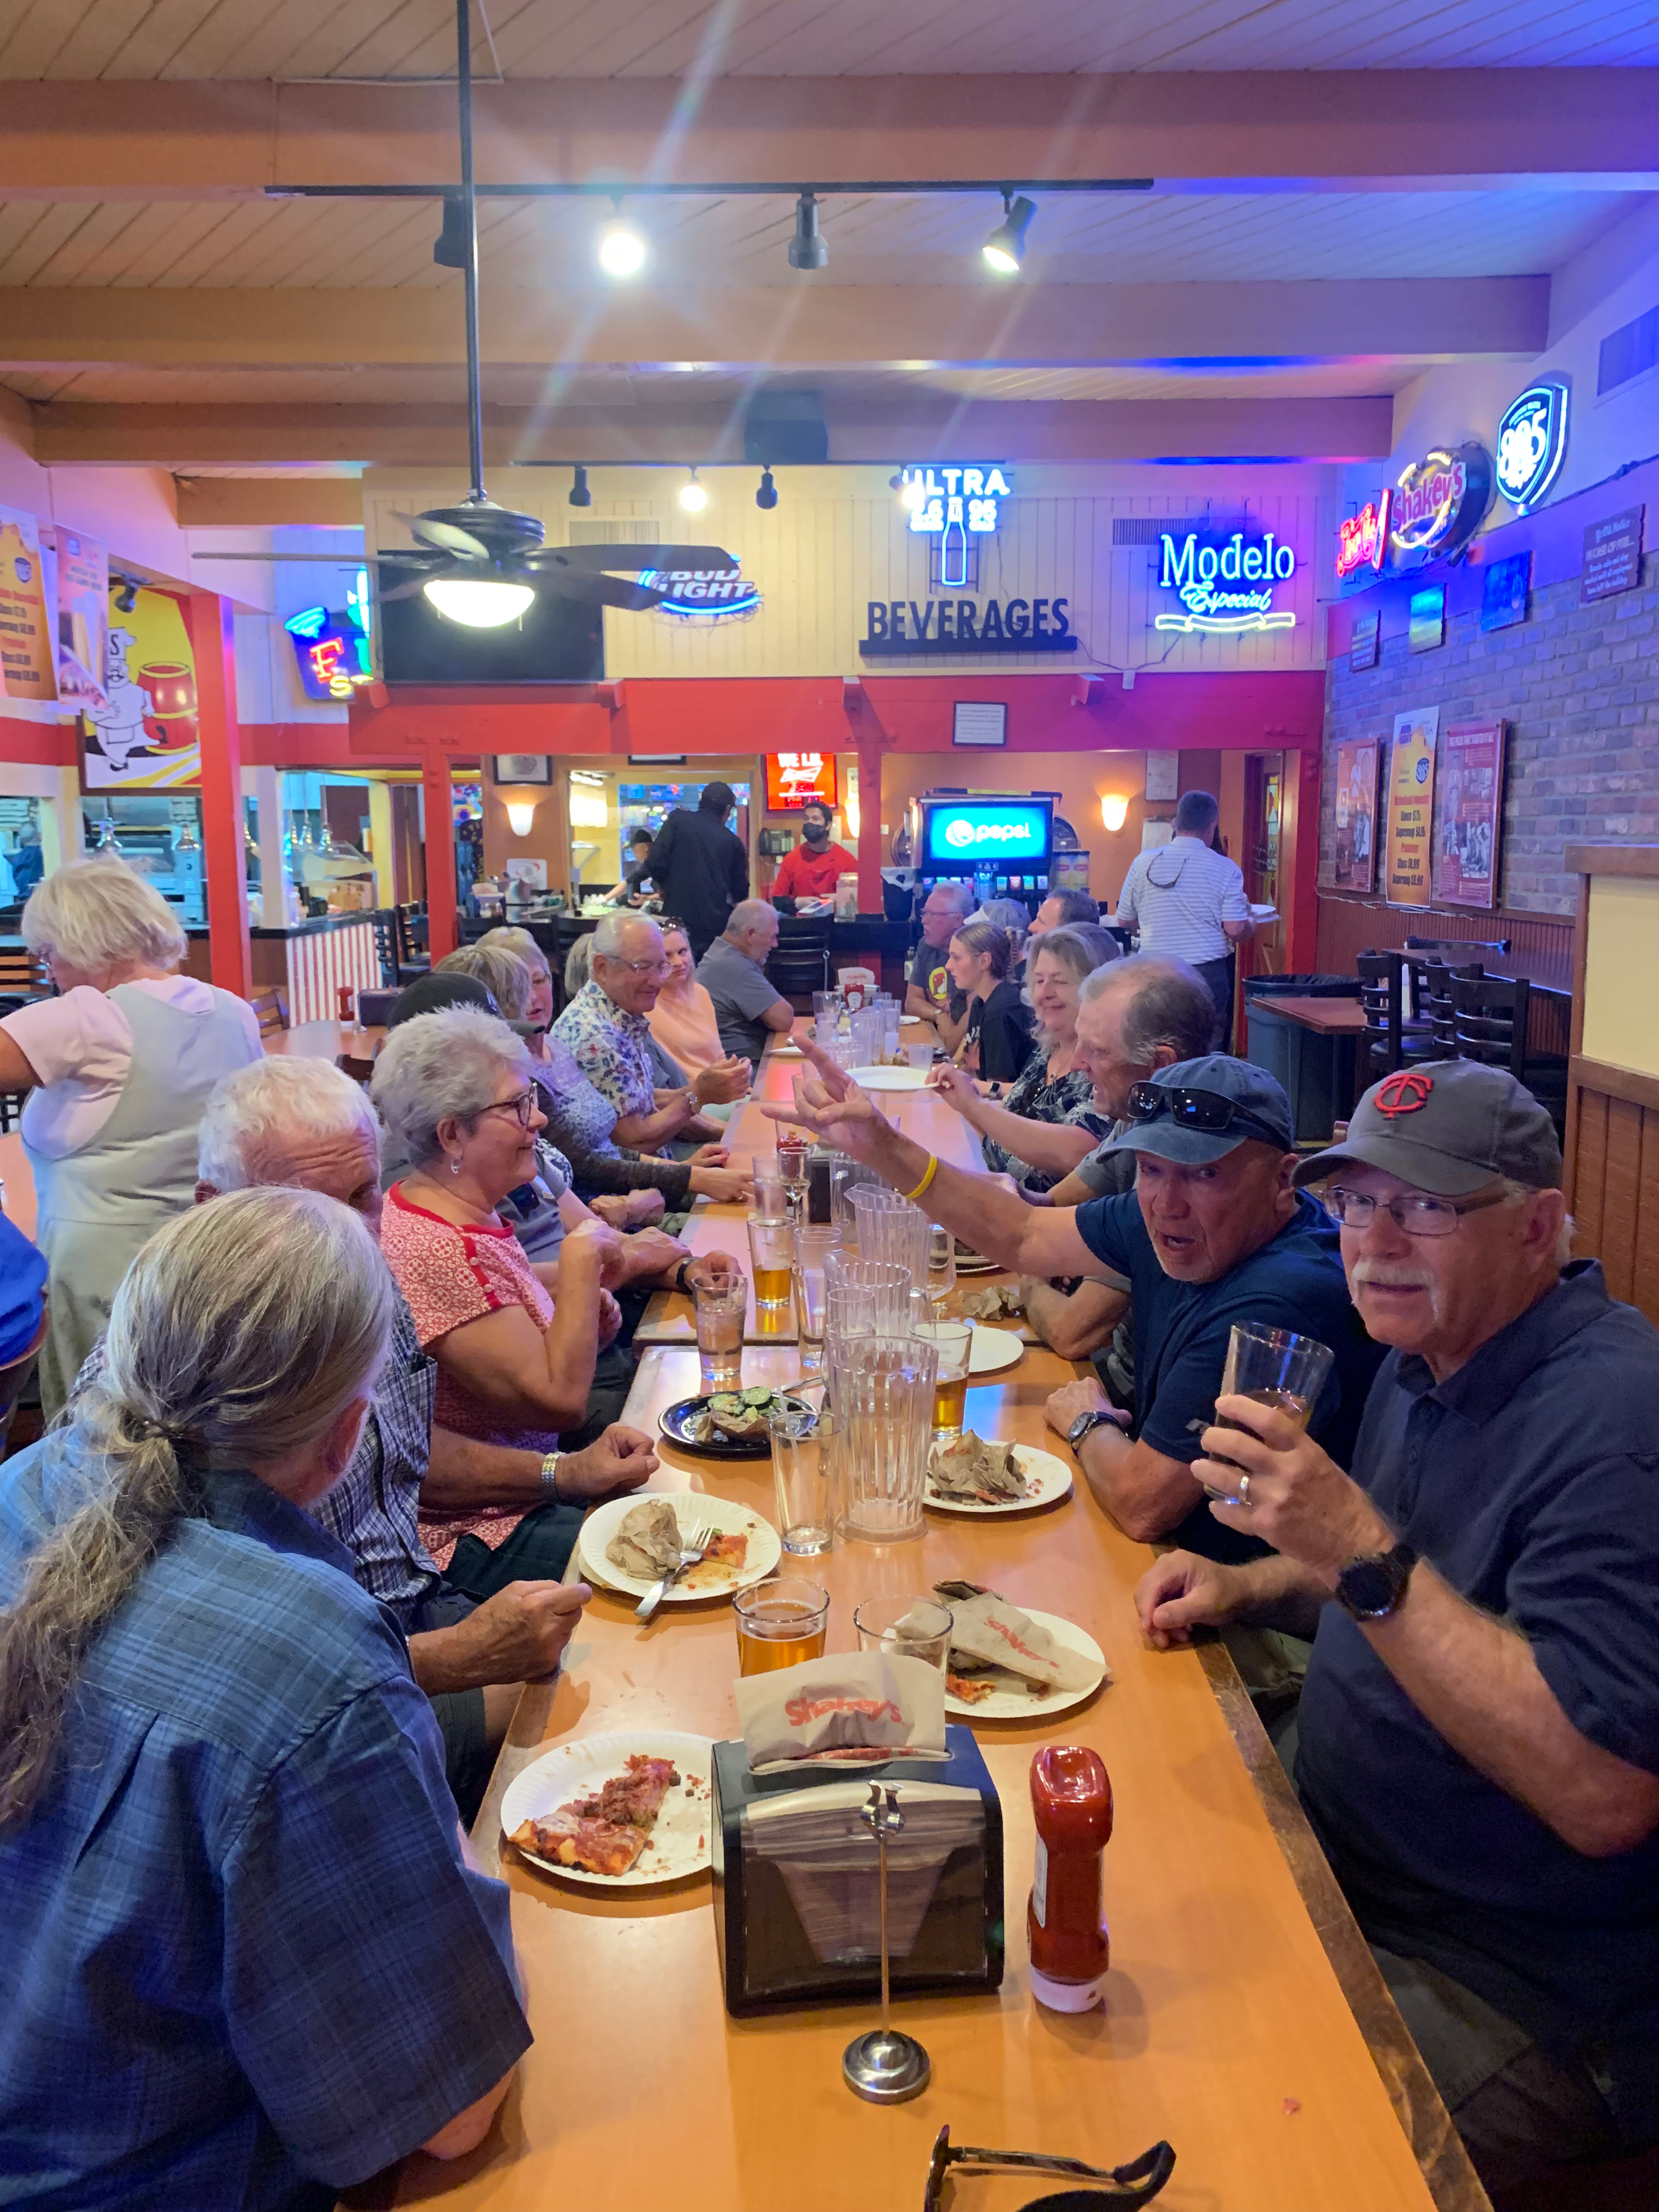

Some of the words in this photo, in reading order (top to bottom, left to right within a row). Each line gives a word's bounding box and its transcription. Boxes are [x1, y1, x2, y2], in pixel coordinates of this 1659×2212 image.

[1499, 408, 1547, 479] 805
[1160, 533, 1295, 586] Modelo
[1180, 581, 1272, 614] Especial
[868, 599, 1069, 640] BEVERAGES
[976, 821, 1032, 843] pepsi
[785, 1696, 902, 1726] Shakey's
